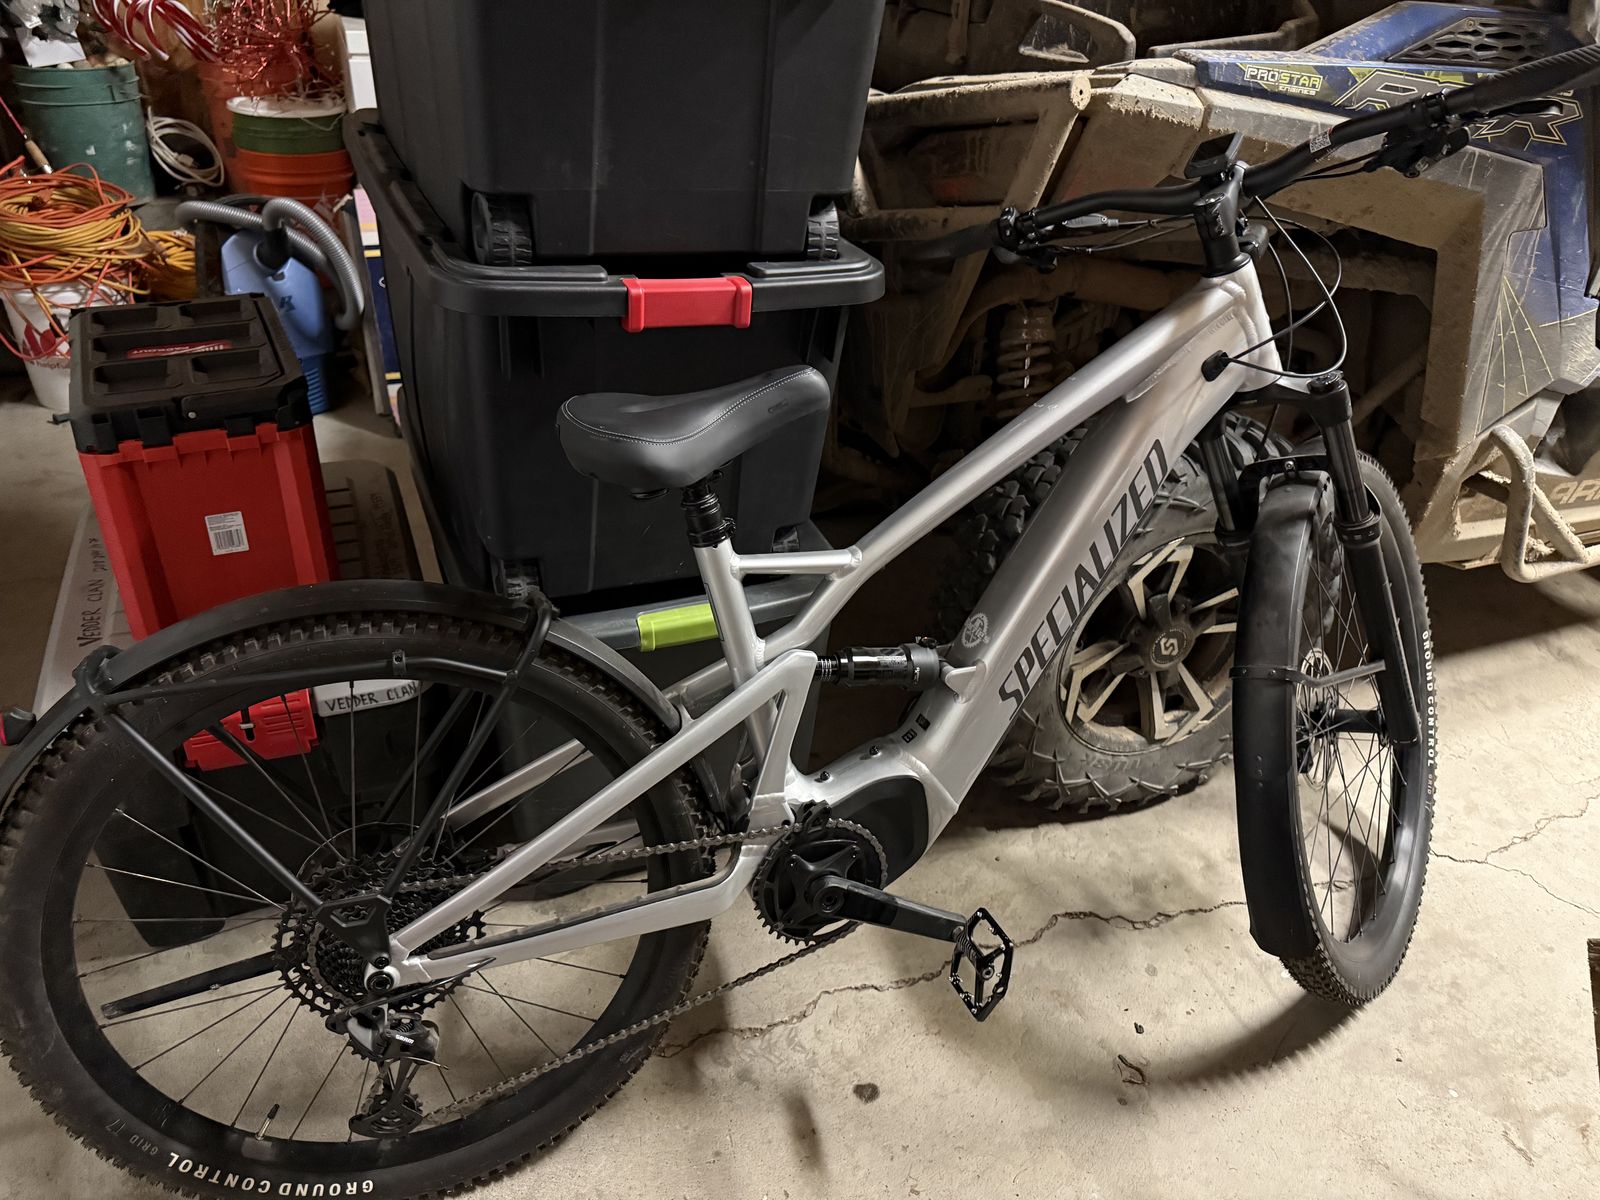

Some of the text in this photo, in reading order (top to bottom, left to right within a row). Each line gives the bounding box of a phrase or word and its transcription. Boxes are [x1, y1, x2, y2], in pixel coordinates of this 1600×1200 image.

[1246, 67, 1321, 90] PROSTAR
[87, 579, 104, 602] CLAN
[998, 438, 1169, 721] SPECIALIZED
[76, 607, 103, 647] VEDDER
[1422, 630, 1433, 692] GROUND
[324, 681, 418, 711] VEDDER CLAN
[1427, 696, 1435, 767] CONTROL
[128, 1134, 159, 1155] GRID
[167, 1151, 271, 1194] CONTROL
[278, 1179, 374, 1197] GROUND
